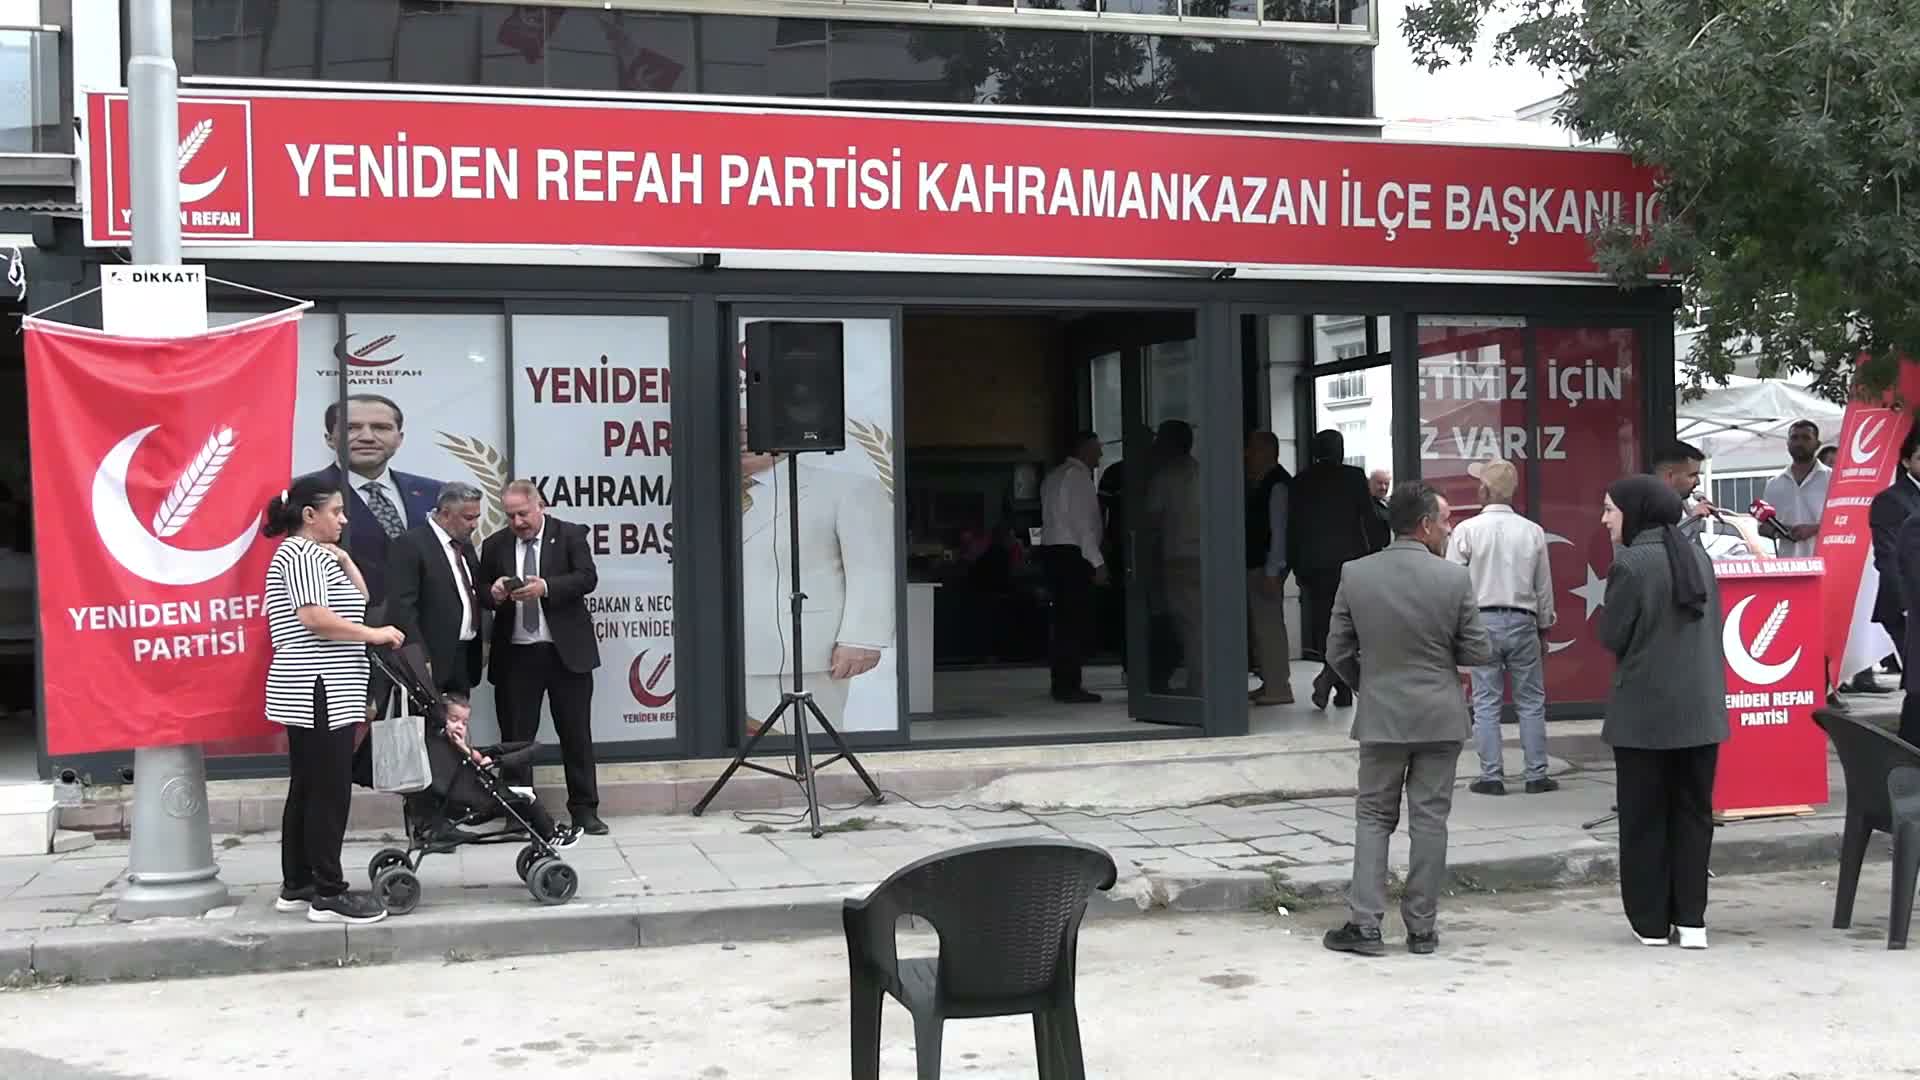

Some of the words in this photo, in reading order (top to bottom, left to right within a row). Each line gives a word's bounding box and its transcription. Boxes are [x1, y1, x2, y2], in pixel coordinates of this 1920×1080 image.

[285, 131, 519, 200] YENİDEN
[536, 148, 702, 205] REFAH
[720, 146, 902, 210] PARTİSİ
[918, 161, 1328, 226] KAHRAMANKAZAN
[1341, 168, 1432, 241] İLÇE
[191, 211, 241, 227] REFAH
[132, 270, 200, 283] DİKKAT!
[1548, 358, 1623, 408] İÇİN
[530, 475, 672, 507] KAHRAM
[634, 596, 644, 612] &
[648, 595, 672, 612] NEC
[68, 599, 201, 631] YENİDEN
[133, 625, 246, 662] PARTİSİ
[1772, 690, 1815, 707] REFAH
[622, 711, 658, 723] YENİDEN
[1740, 708, 1789, 726] PARTİSİ
